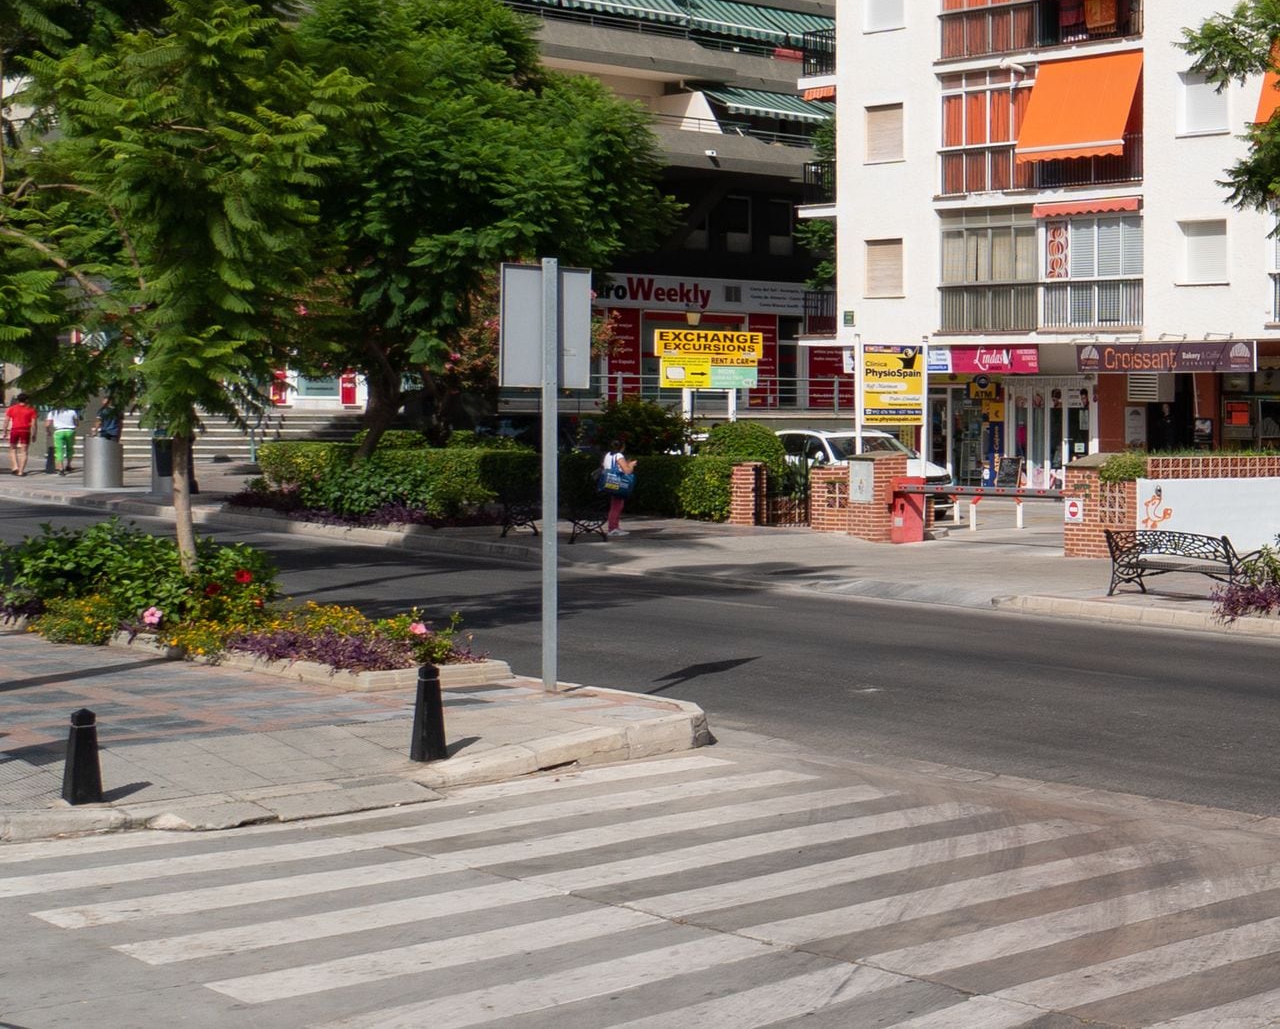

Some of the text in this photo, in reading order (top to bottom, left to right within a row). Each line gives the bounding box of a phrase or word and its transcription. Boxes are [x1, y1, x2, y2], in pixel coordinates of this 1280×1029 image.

[659, 331, 760, 344] EXCHANGE
[663, 342, 756, 352] EXCURSIONS
[1104, 347, 1177, 369] Croissant
[865, 368, 922, 378] PhysioSpain
